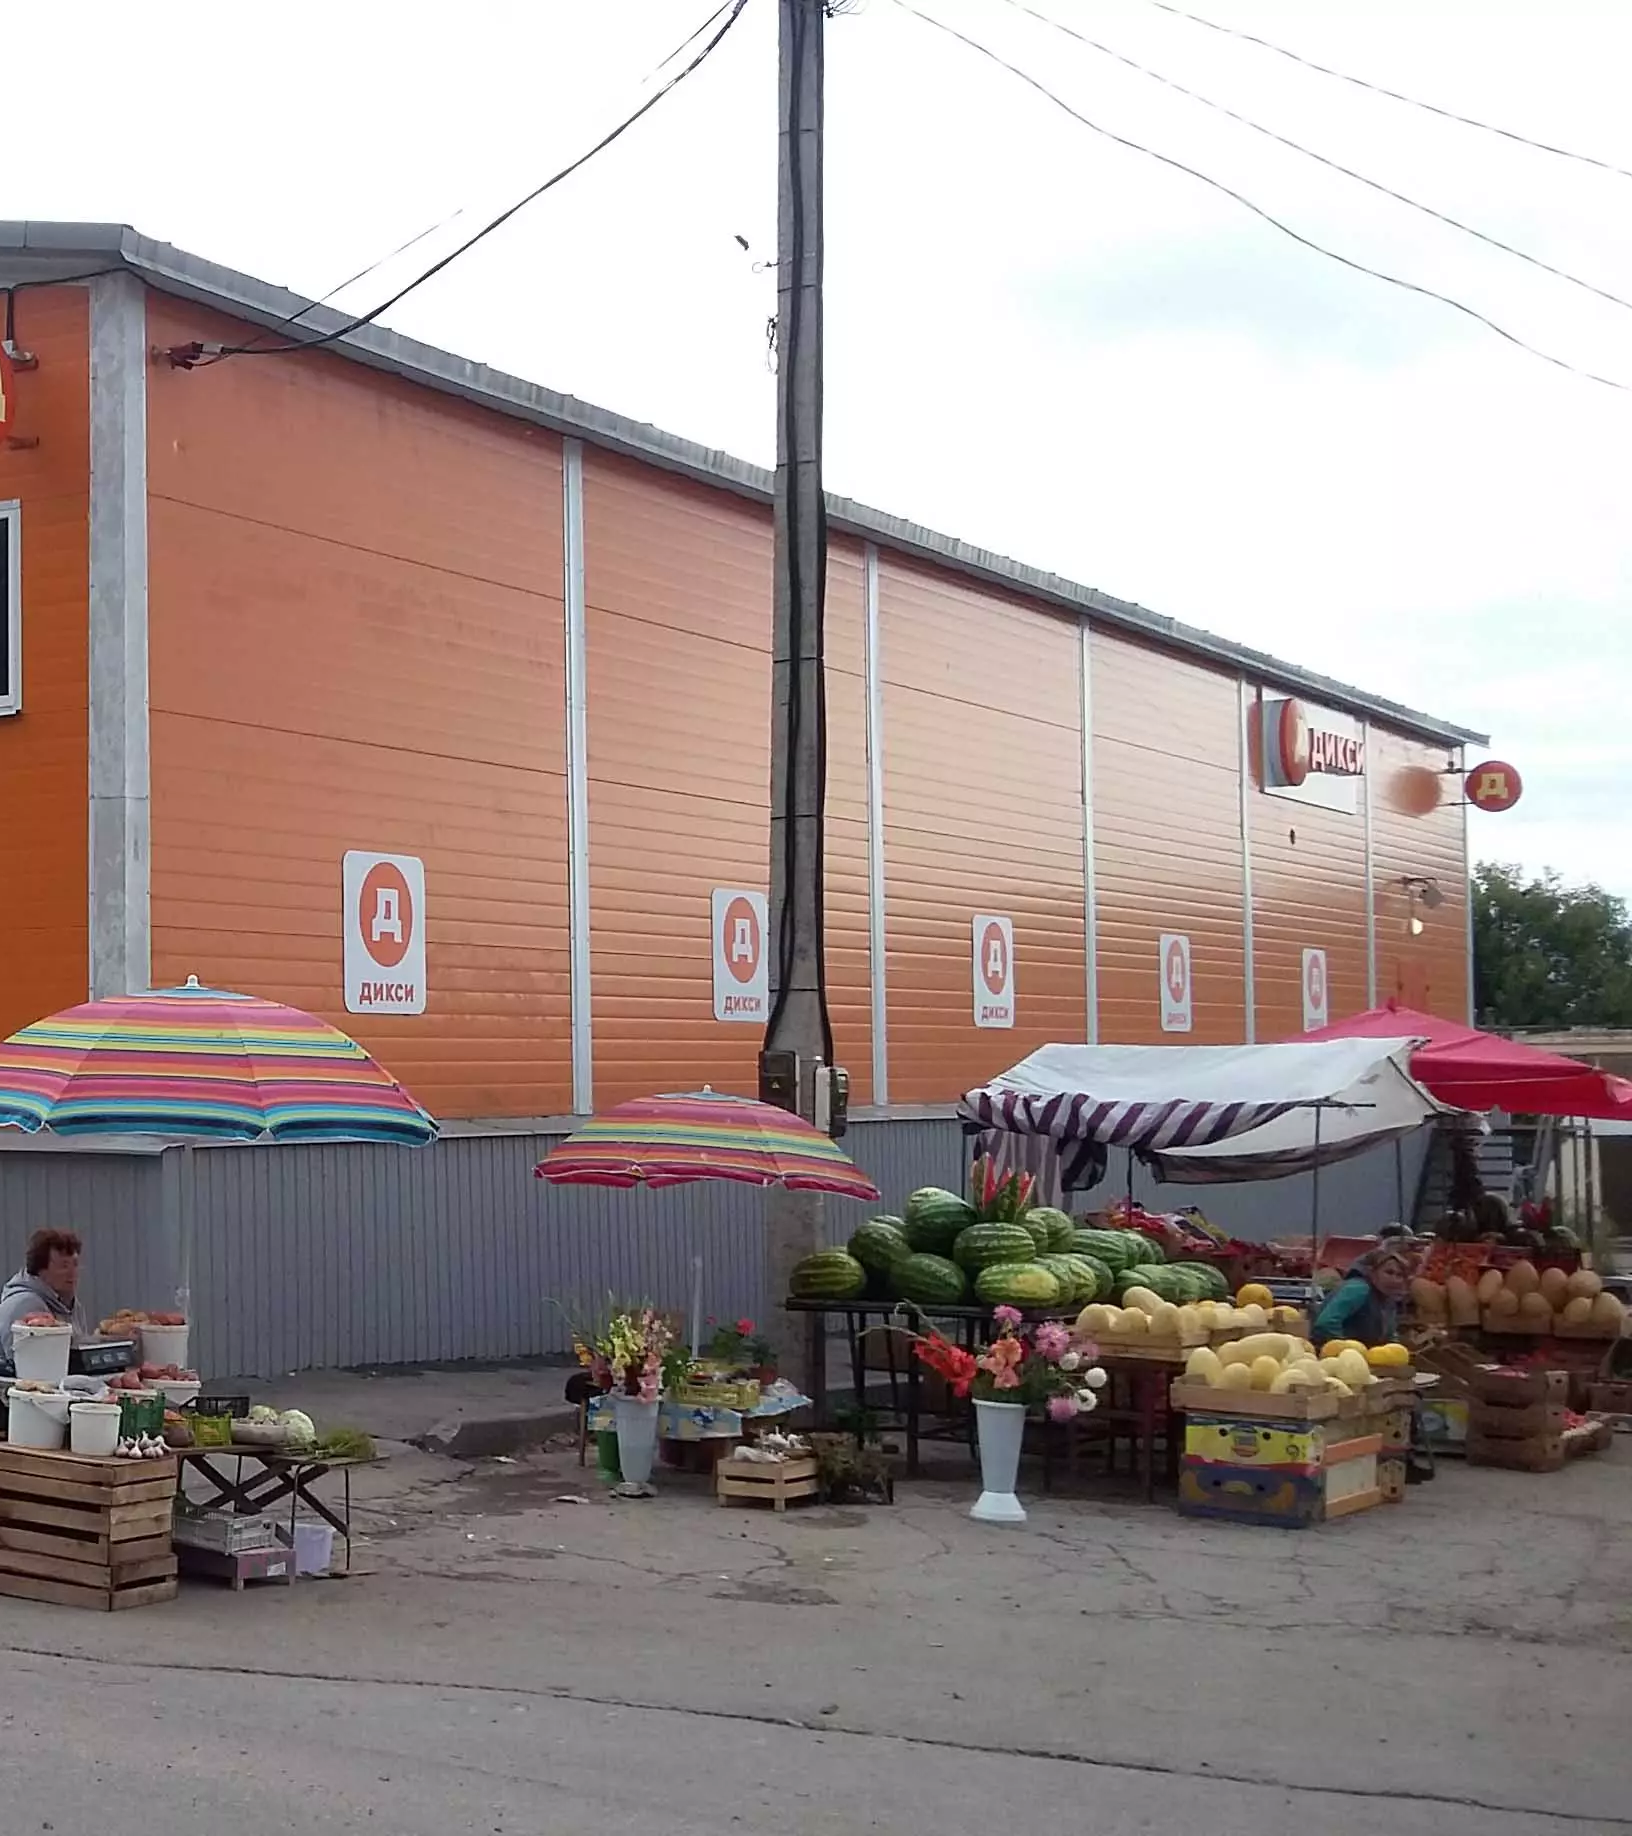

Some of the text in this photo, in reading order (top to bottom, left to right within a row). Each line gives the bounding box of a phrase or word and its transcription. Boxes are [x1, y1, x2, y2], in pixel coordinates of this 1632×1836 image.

[371, 888, 403, 943] Д
[732, 918, 754, 963] Д
[359, 981, 415, 1005] ДИКСИ
[723, 995, 762, 1015] ДИКСИ
